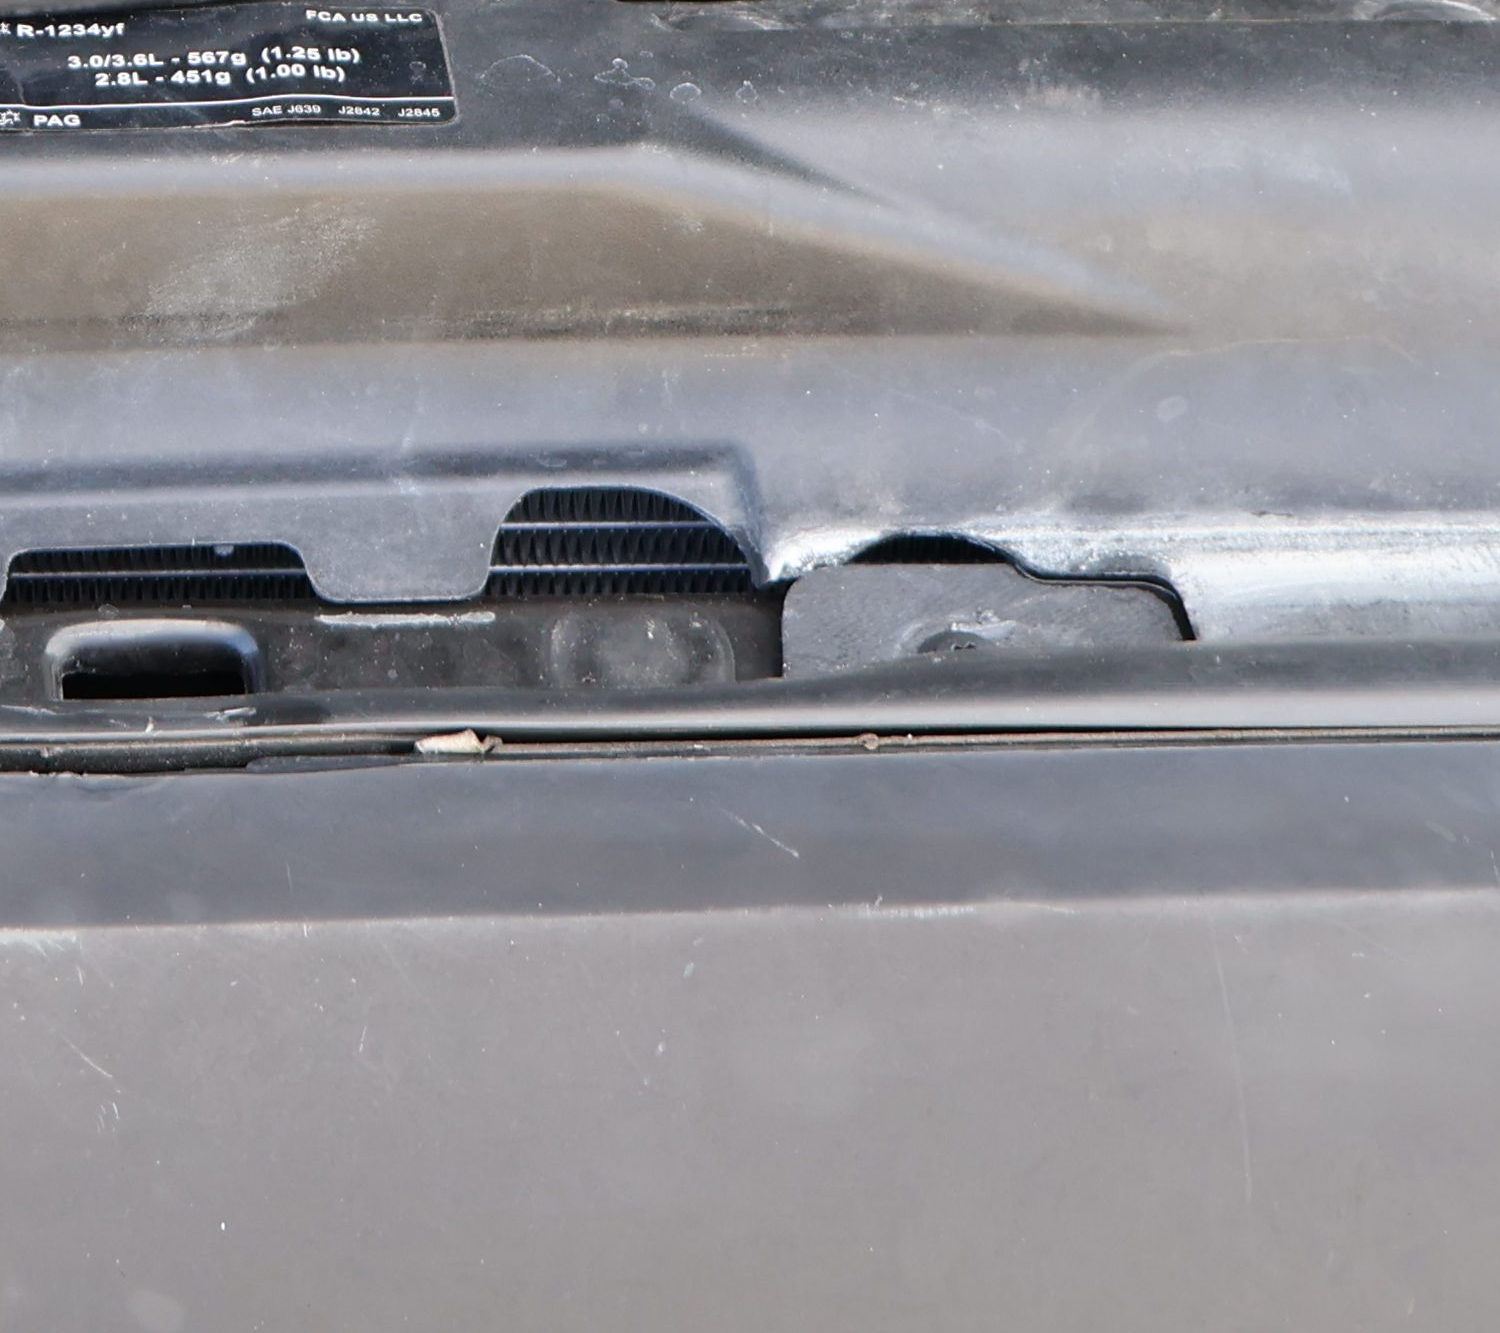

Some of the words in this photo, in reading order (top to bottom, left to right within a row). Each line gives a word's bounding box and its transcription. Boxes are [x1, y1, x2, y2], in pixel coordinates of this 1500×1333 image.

[305, 10, 347, 23] FCA
[351, 13, 379, 23] US
[384, 12, 423, 23] LLC
[16, 22, 126, 39] R-1234yf
[67, 53, 165, 69] 3.0/3.6L
[187, 50, 247, 66] 567g
[260, 45, 321, 65] (1.25
[328, 47, 361, 64] lb)
[95, 71, 149, 88] 2.8L
[170, 69, 232, 86] 451g
[245, 63, 306, 84] (1.00
[313, 65, 346, 83] lb)
[251, 105, 283, 117] SAE
[287, 104, 322, 115] J639
[338, 105, 381, 117] J2842
[397, 106, 441, 118] J2845
[33, 114, 81, 127] PAG
